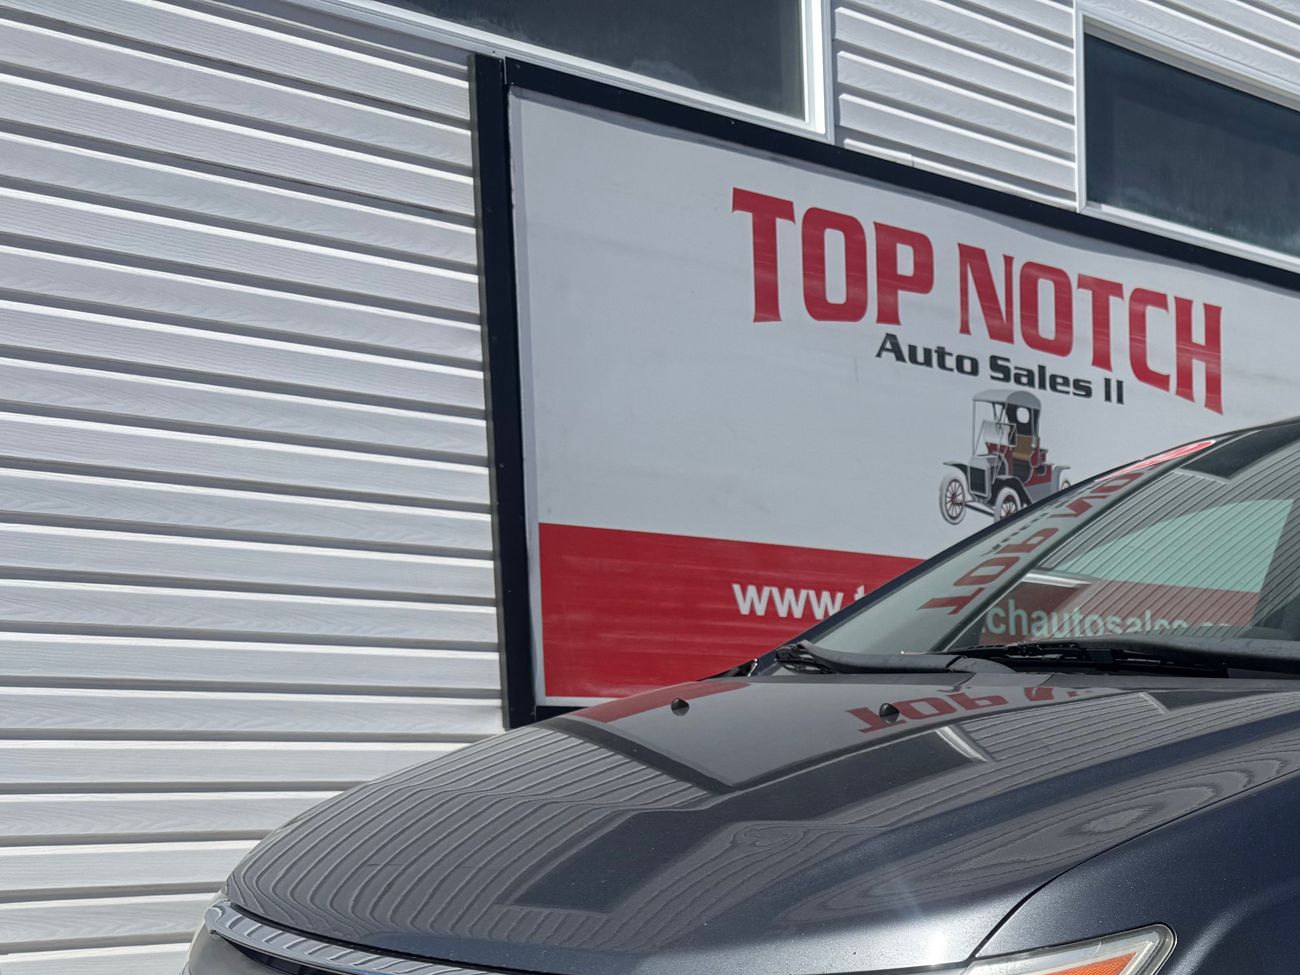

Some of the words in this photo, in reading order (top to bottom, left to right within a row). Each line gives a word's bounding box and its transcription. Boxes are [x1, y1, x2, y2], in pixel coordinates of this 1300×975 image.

[732, 187, 934, 325] TOP
[957, 242, 1223, 415] NOTCH
[875, 333, 980, 377] Auto
[989, 354, 1093, 399] Sales
[1103, 377, 1125, 405] II
